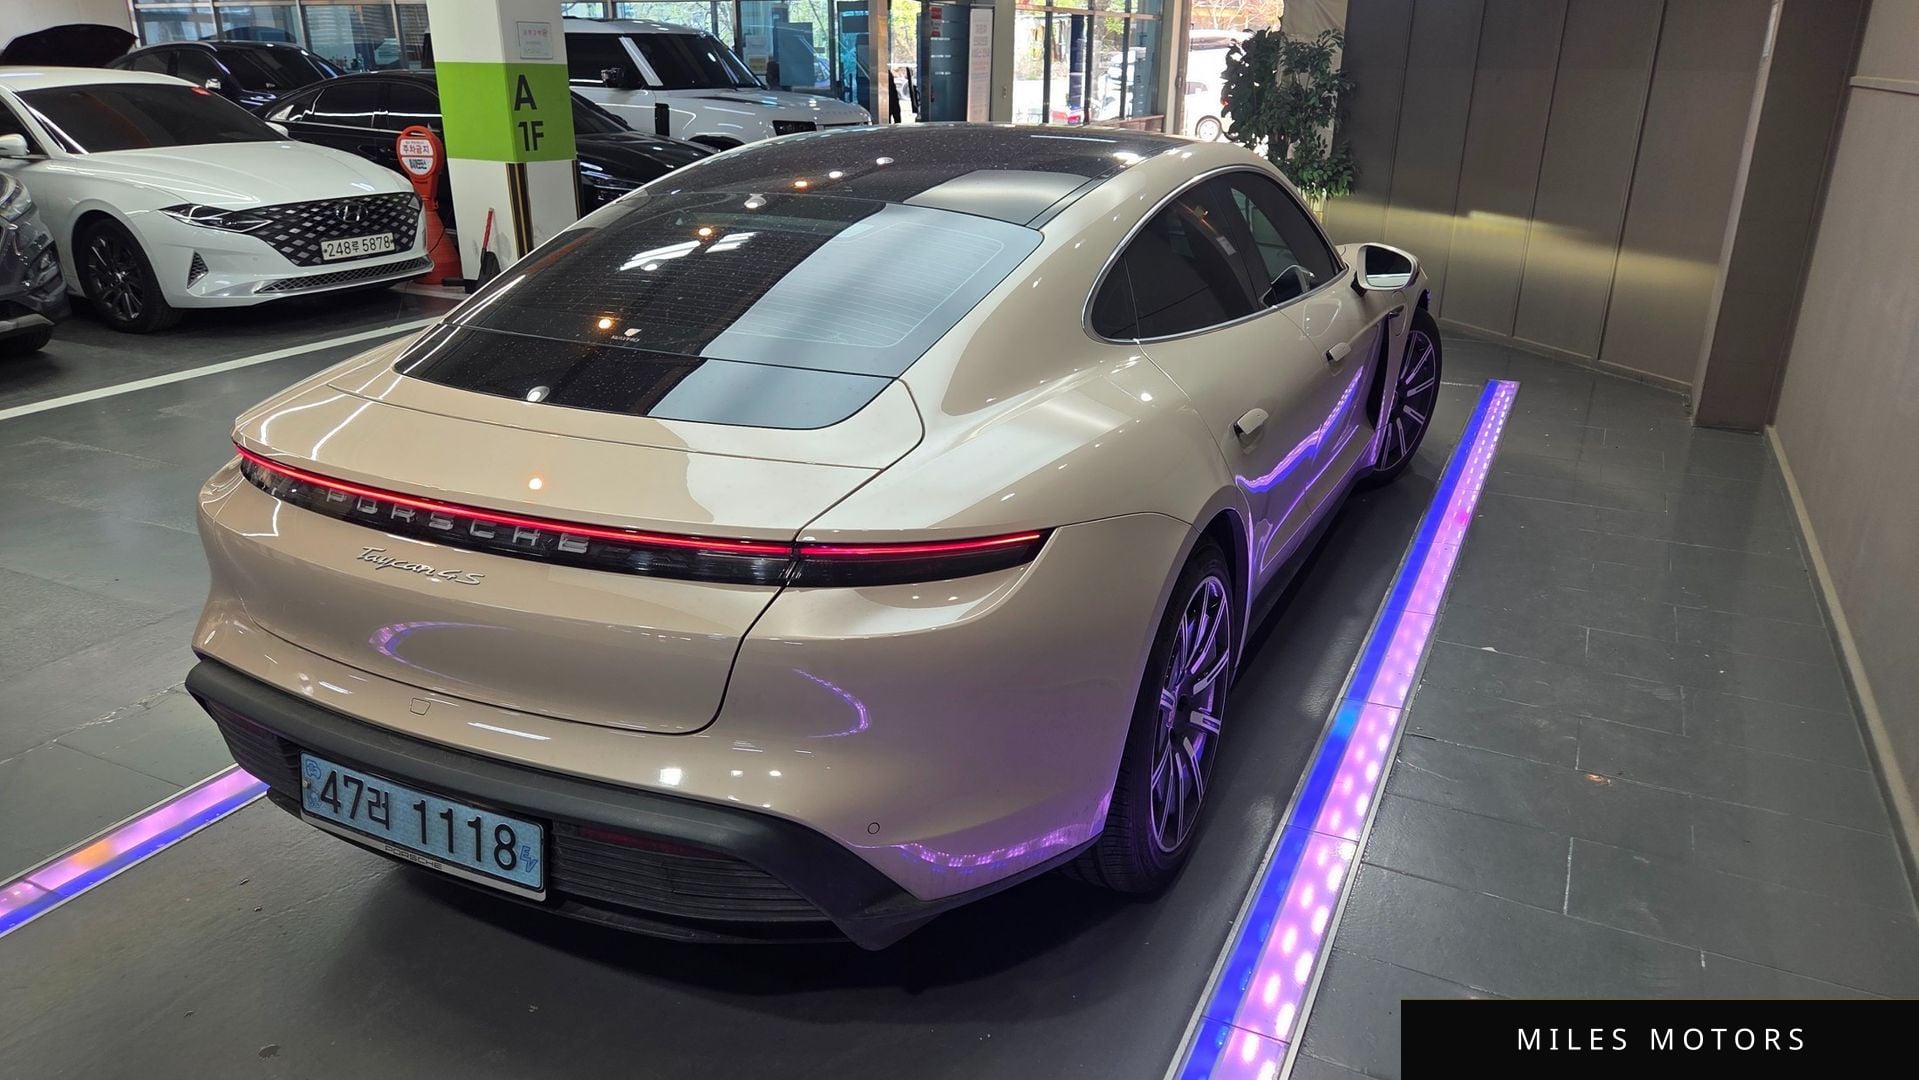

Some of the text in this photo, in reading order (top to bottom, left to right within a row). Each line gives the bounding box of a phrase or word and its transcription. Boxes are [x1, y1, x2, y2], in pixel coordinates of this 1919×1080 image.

[513, 74, 537, 112] A
[402, 144, 430, 154] 주차금지
[518, 121, 544, 152] 1F
[326, 235, 390, 257] 248루 5878
[326, 488, 590, 554] PORSCHE
[357, 546, 435, 576] Taycan
[320, 770, 517, 871] 47러 1118
[384, 844, 443, 870] PORSCHE
[519, 845, 539, 873] EV
